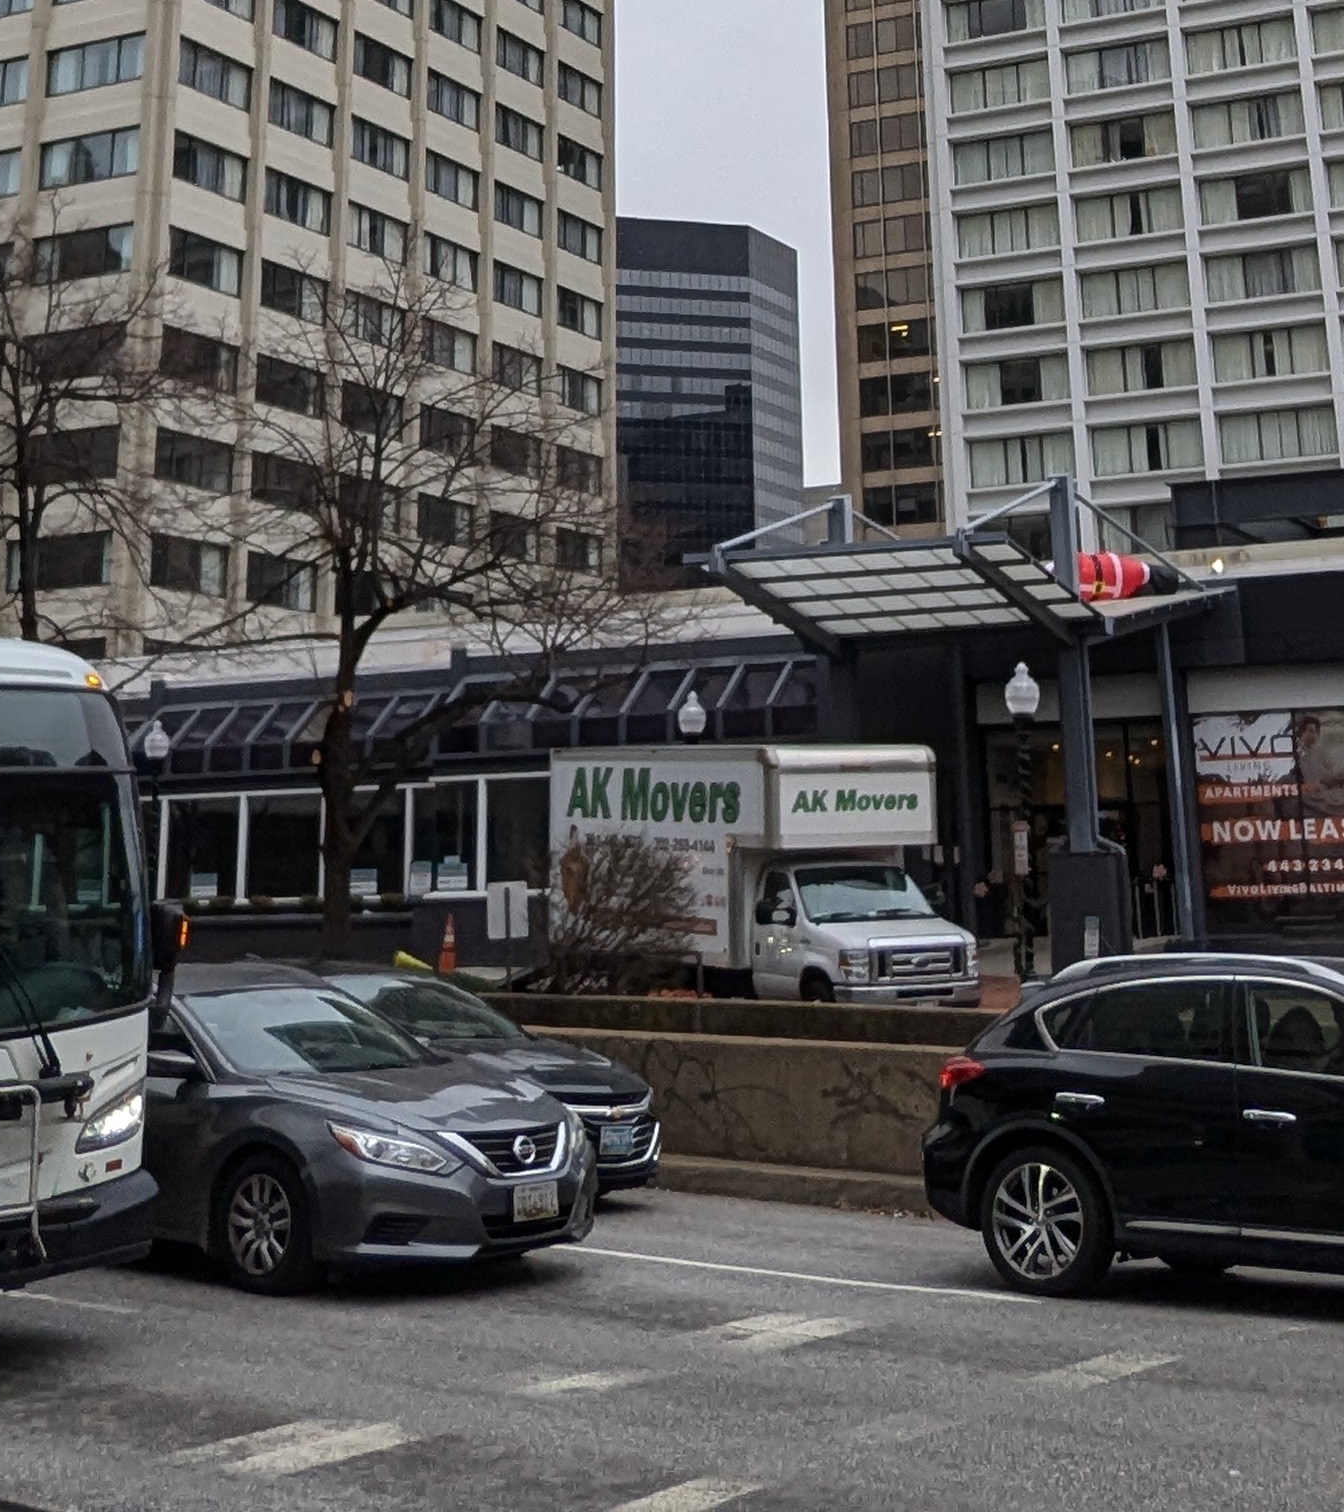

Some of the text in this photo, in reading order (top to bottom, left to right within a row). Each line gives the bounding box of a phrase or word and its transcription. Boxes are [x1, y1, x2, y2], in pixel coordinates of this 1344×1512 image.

[1199, 734, 1296, 758] VIVO
[567, 767, 741, 824] AK Movers
[791, 789, 919, 813] AK Movers
[1204, 783, 1299, 800] APARTMENTS
[1212, 819, 1282, 843] NOW
